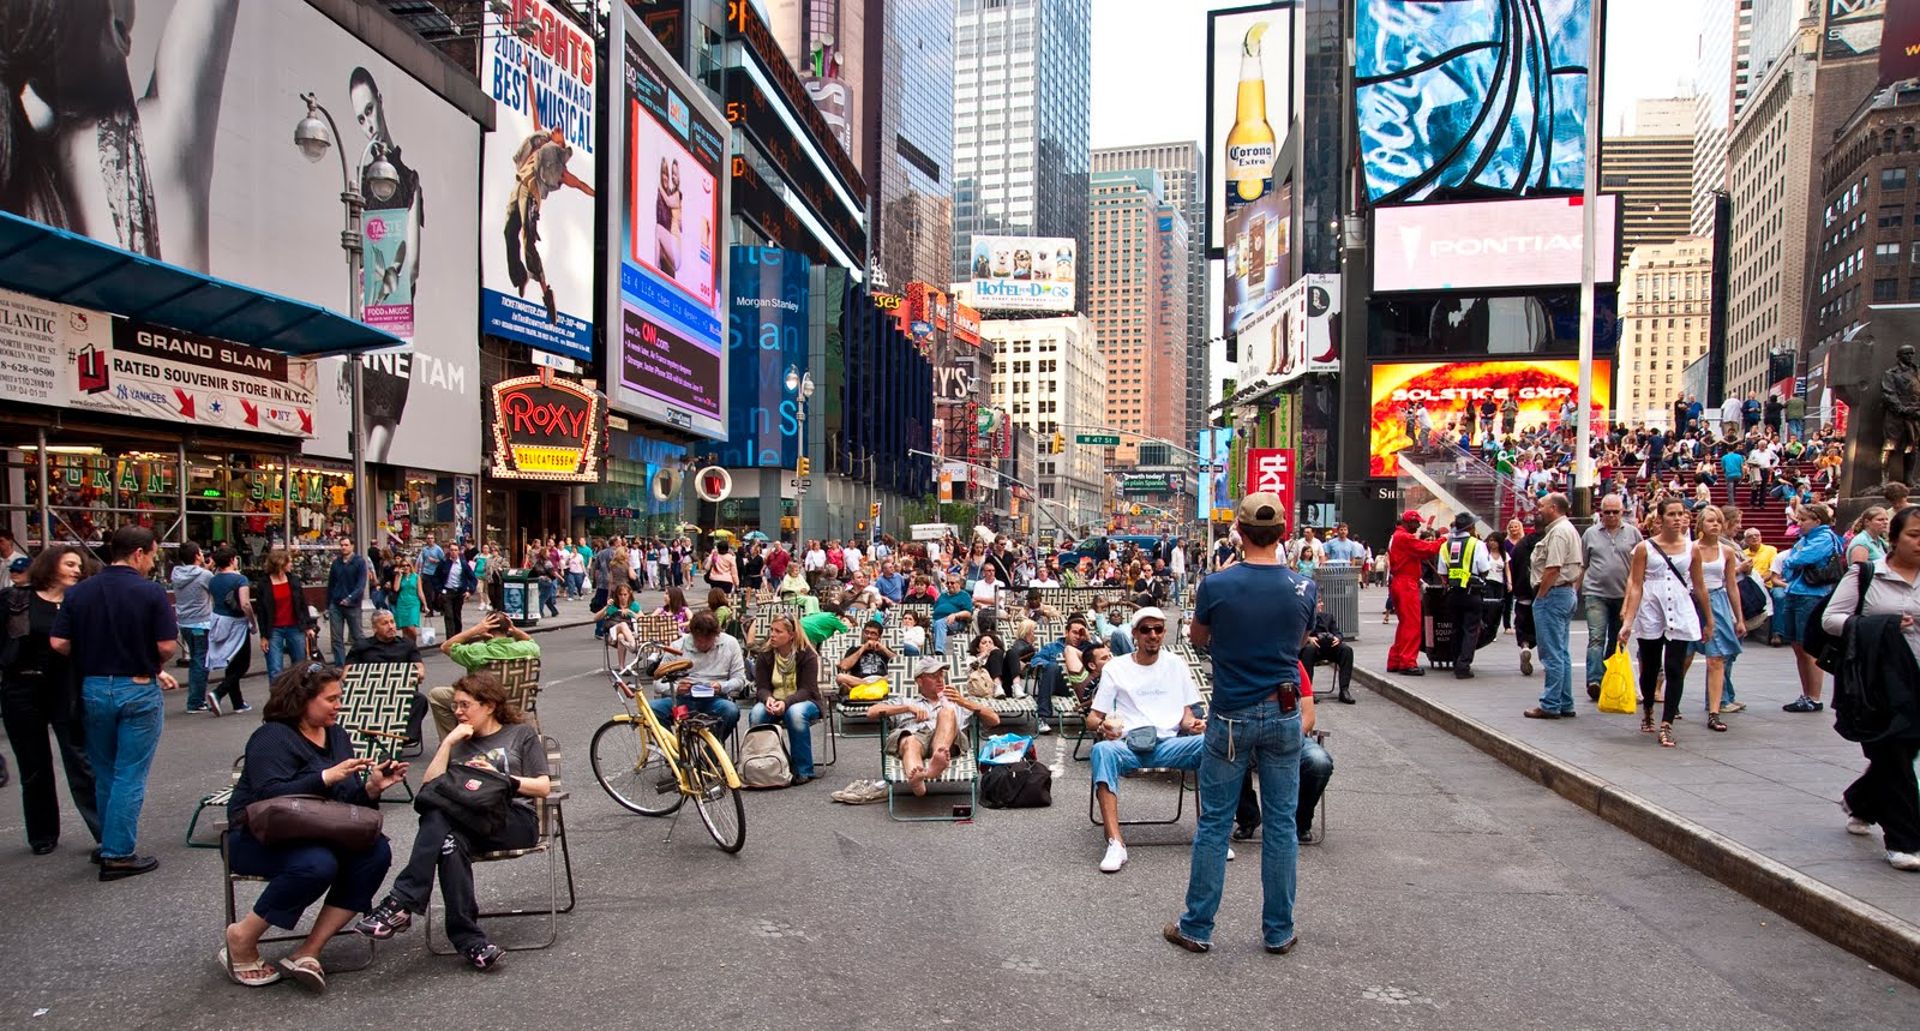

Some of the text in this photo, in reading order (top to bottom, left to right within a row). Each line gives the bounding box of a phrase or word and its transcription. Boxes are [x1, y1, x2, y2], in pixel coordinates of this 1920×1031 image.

[494, 30, 522, 68] 2008
[528, 50, 553, 87] TONY
[558, 72, 592, 112] AWARD
[493, 55, 528, 117] BEST
[536, 82, 593, 155] MUSICAL
[1230, 145, 1271, 160] Corona
[1239, 158, 1266, 167] Extra
[368, 308, 385, 316] FOOD
[389, 306, 409, 314] MUSIC
[736, 296, 799, 313] Morgan Stanley
[874, 294, 902, 310] se's
[137, 331, 272, 372] GRAND SLAM
[114, 358, 312, 405] RATED SOUVENIR STORE IN N.Y.C.
[414, 351, 464, 395] TAM
[933, 366, 967, 398] Y'S
[130, 388, 167, 404] YANKEES
[1392, 387, 1509, 402] SOLSTICE
[503, 392, 585, 438] ROXY
[518, 452, 575, 466] DELICATESSEN
[66, 456, 323, 504] GRAND SLAM
[1130, 480, 1144, 488] plain
[1259, 454, 1288, 493] tkt
